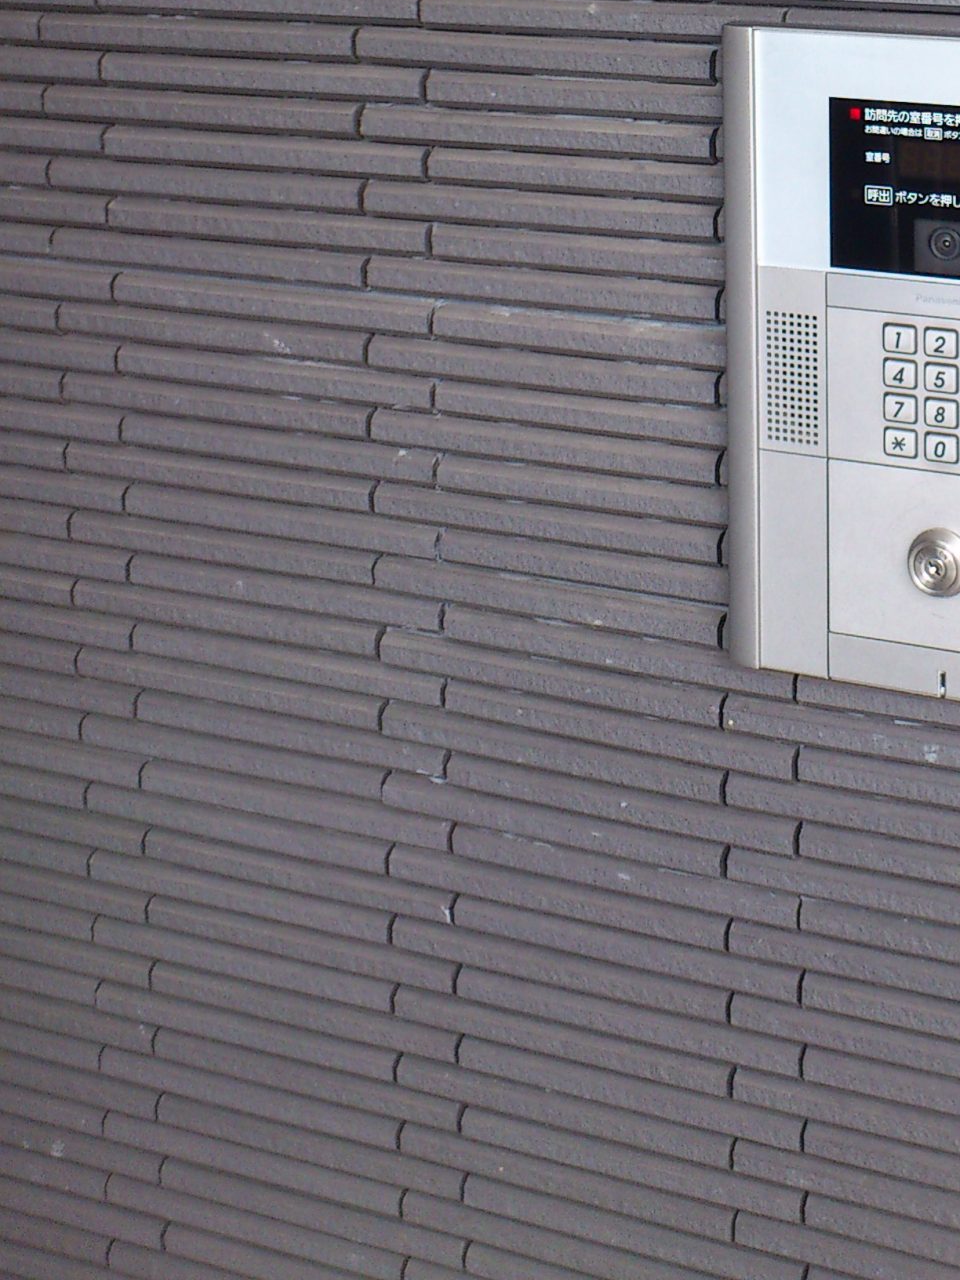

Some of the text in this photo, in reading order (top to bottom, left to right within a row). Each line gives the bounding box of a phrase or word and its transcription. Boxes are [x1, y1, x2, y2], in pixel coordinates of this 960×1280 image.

[865, 151, 891, 164] 室番号
[867, 188, 891, 203] 呼出
[895, 332, 901, 349] 1
[934, 337, 946, 353] 2
[893, 367, 904, 384] 4
[934, 371, 946, 388] 5
[894, 402, 904, 418] 7
[934, 407, 945, 423] 8
[935, 442, 945, 457] 0
